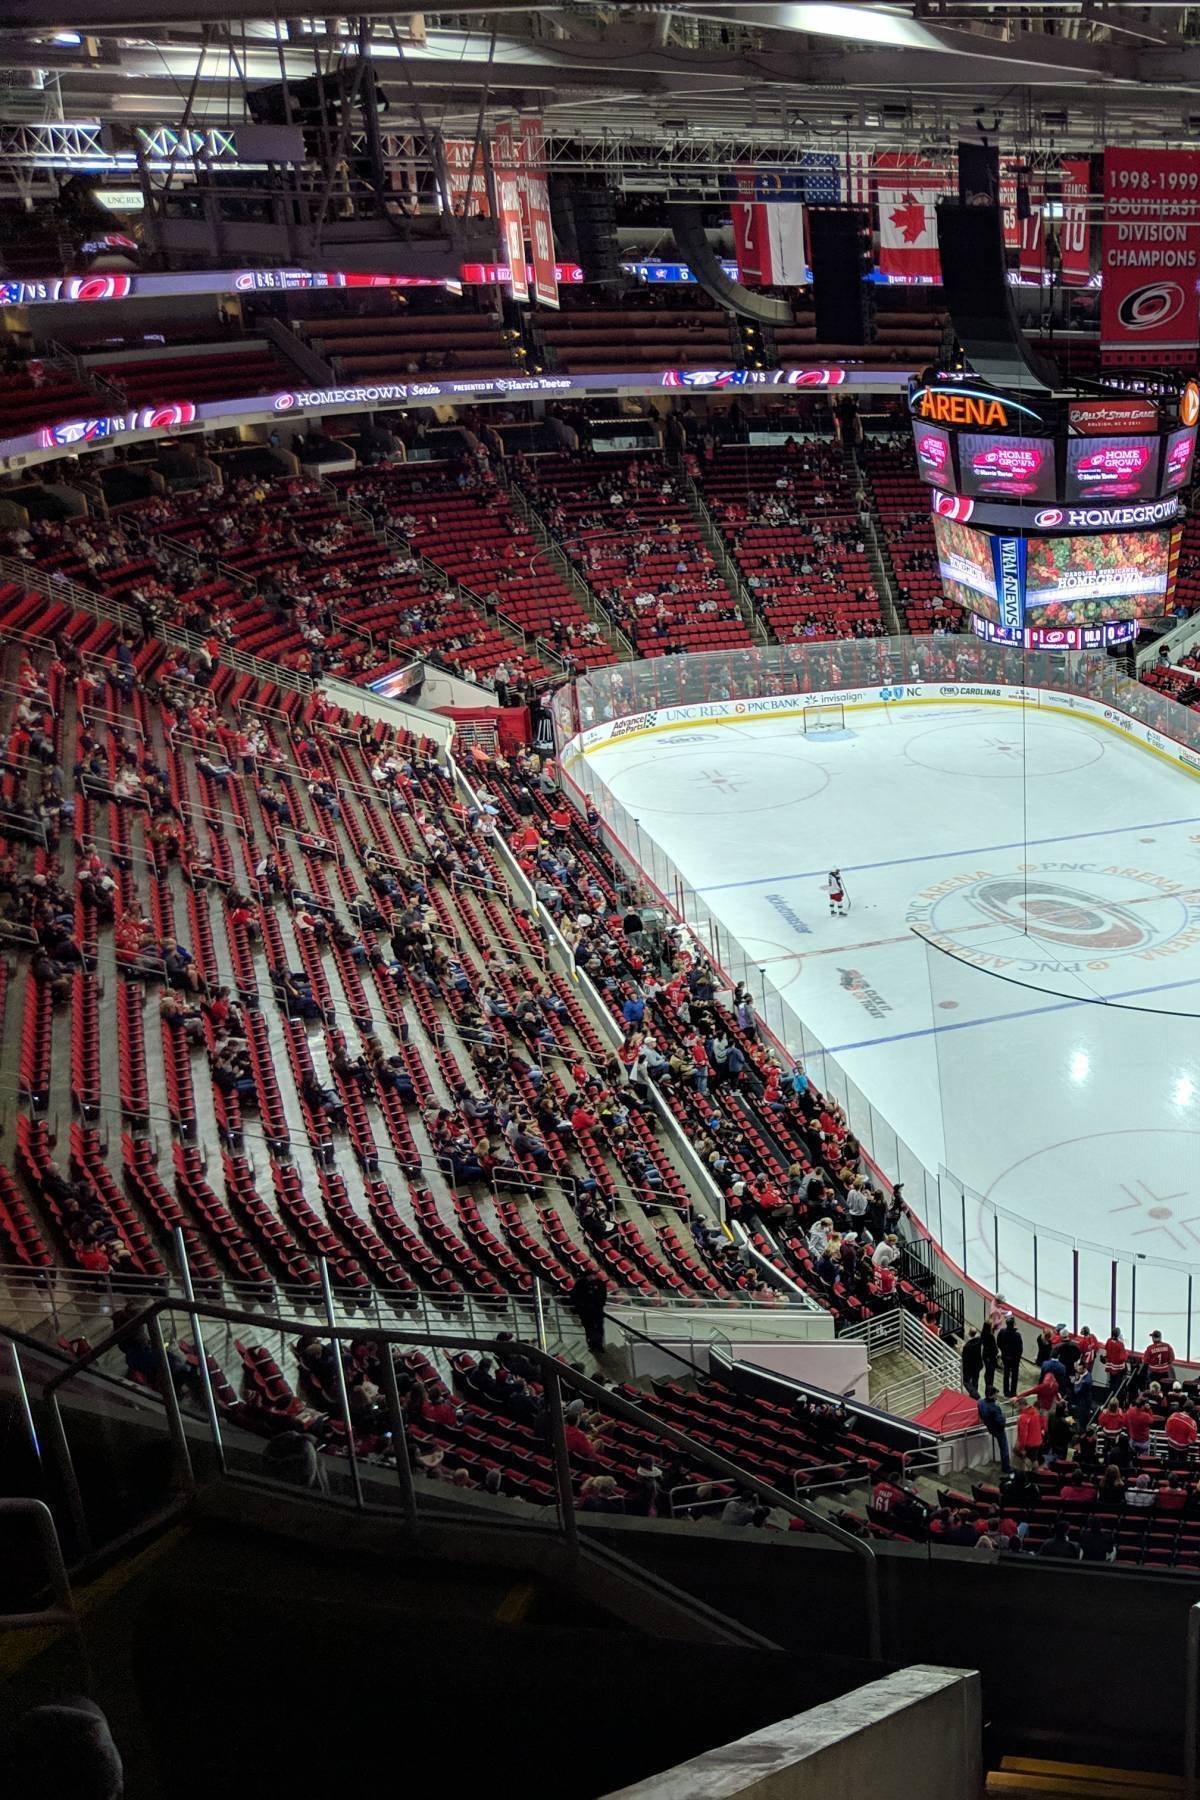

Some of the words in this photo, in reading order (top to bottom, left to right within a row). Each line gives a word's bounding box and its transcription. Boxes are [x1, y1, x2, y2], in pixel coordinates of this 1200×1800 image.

[1109, 170, 1198, 190] 1998-1999
[107, 196, 125, 205] UNC
[126, 196, 143, 204] REX
[1108, 198, 1197, 217] SOUTHEAST
[743, 203, 754, 249] 2
[1117, 224, 1188, 242] DIVISION
[1107, 250, 1197, 268] CHAMPIONS
[257, 273, 275, 287] 6:45
[27, 284, 47, 299] VS
[752, 372, 766, 383] VS
[297, 385, 408, 407] HOMEGROWN
[412, 384, 441, 397] Series
[454, 383, 479, 392] PRESENTED
[481, 383, 494, 391] BY
[508, 379, 538, 390] Harris
[540, 378, 572, 388] Teeter
[920, 386, 1009, 428] ARENA
[112, 417, 126, 432] VS
[998, 450, 1033, 460] HOME
[1105, 450, 1140, 459] HOME
[1105, 458, 1142, 467] GROWN
[998, 459, 1036, 467] GROWN
[1067, 497, 1178, 527] HOMEGROWN
[1001, 541, 1016, 575] WRAL
[1057, 571, 1144, 590] HOMEGROWN
[1004, 578, 1018, 626] NEWS
[1066, 630, 1074, 643] 0
[820, 691, 863, 704] invisalign
[906, 687, 922, 697] NC
[960, 687, 1001, 697] CAROLINAS
[666, 706, 697, 721] UNC
[699, 703, 729, 717] REX
[613, 715, 645, 730] Advance
[610, 728, 626, 738] Auto
[1041, 862, 1097, 871] PNC
[1103, 866, 1183, 892] ARENA
[918, 870, 993, 901] ARENA
[905, 901, 933, 923] PNC
